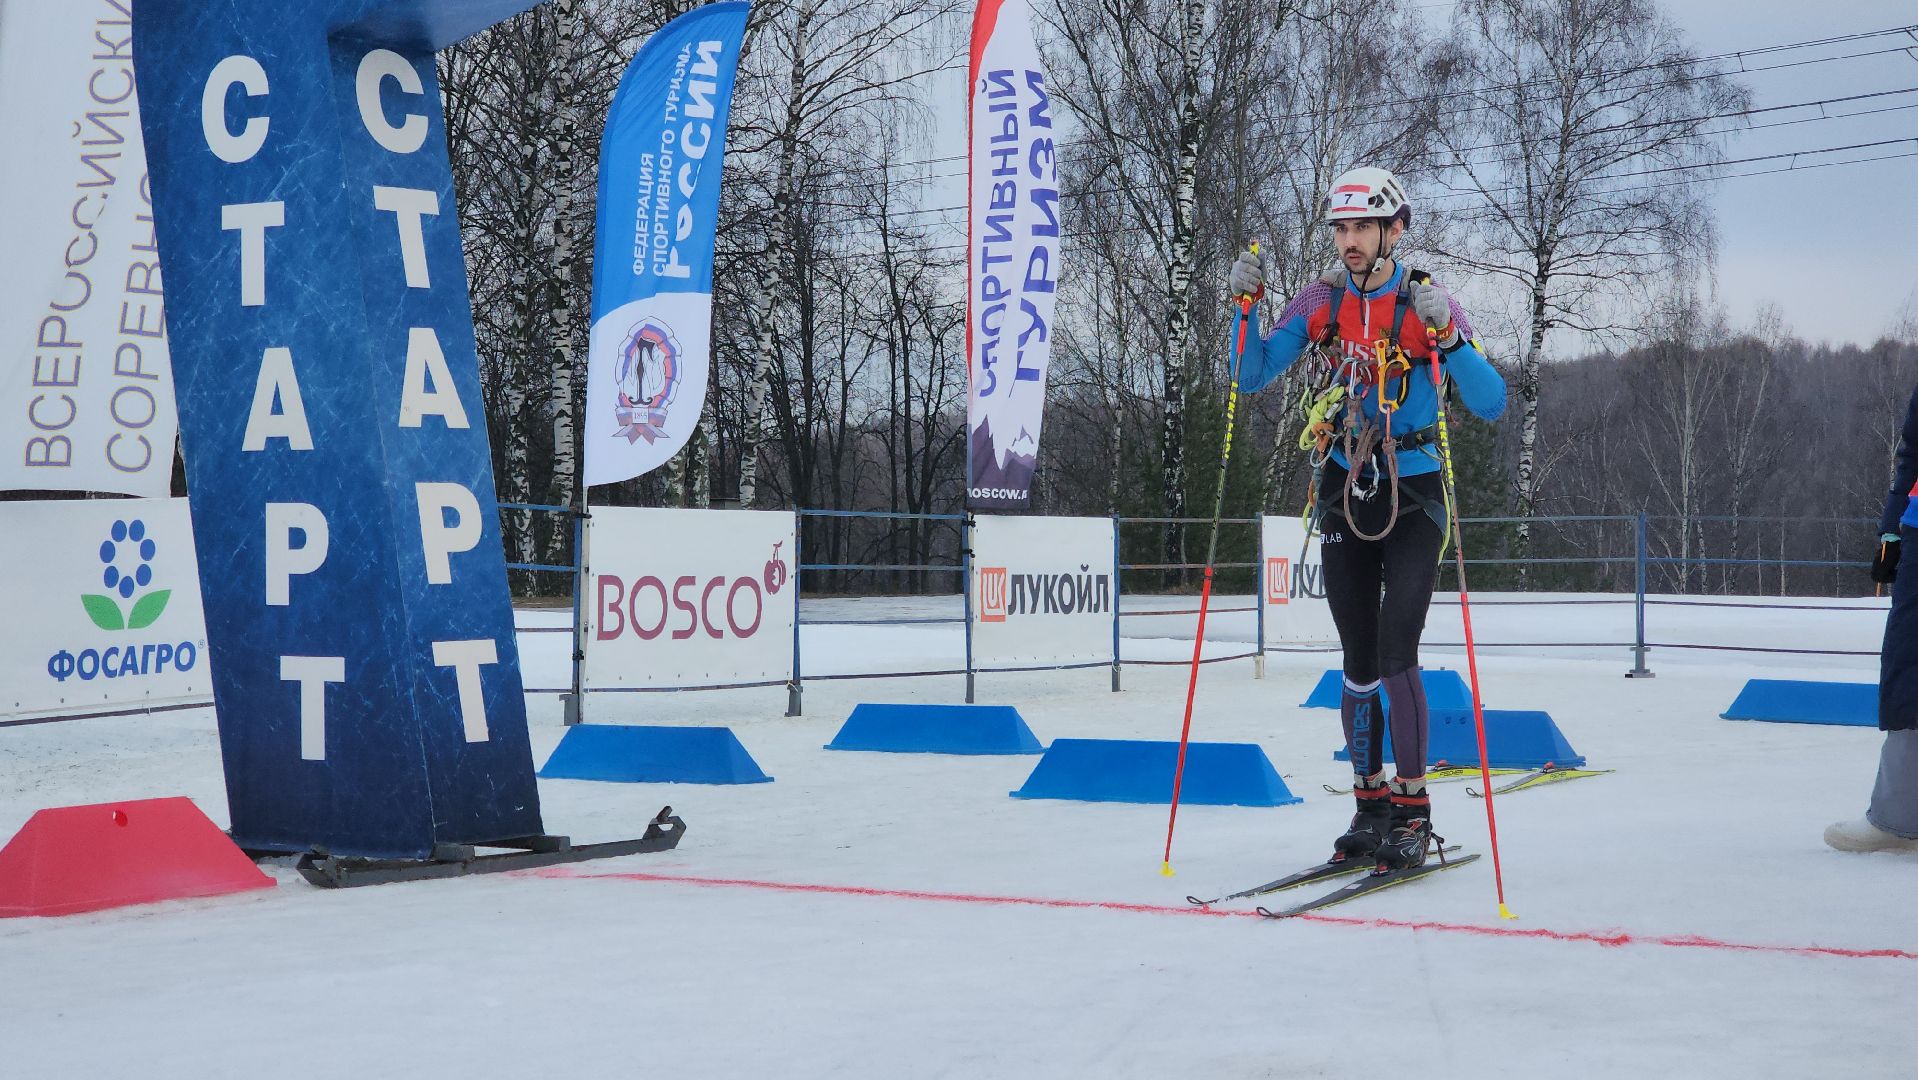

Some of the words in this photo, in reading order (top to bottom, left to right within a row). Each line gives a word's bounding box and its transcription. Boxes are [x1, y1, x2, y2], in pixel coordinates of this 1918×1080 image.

[632, 153, 655, 275] ФЕДЕРАЦИЯ
[653, 130, 676, 277] СПОРТИВНОГО
[1345, 194, 1352, 204] 7
[202, 55, 345, 761] СТАРТ
[355, 48, 498, 743] СТАРТ
[597, 575, 762, 640] BOSCO
[1008, 563, 1109, 616] ЛУКОЙЛ
[47, 641, 196, 682] ФОСАГРО
